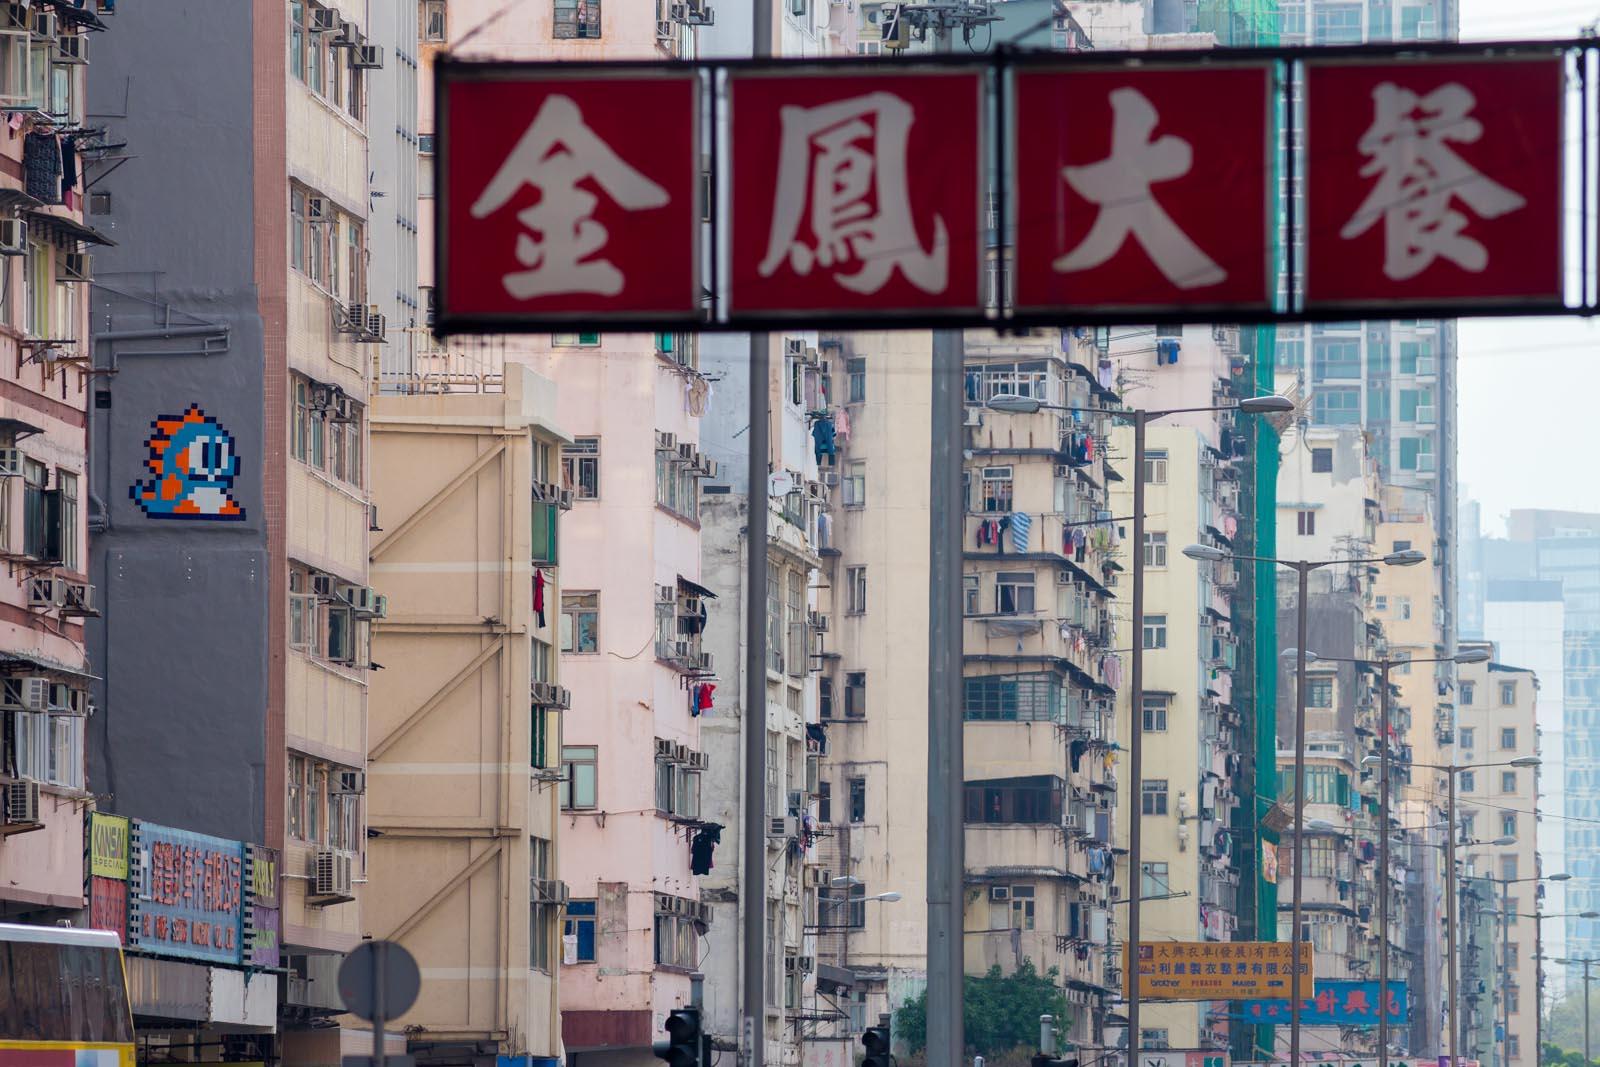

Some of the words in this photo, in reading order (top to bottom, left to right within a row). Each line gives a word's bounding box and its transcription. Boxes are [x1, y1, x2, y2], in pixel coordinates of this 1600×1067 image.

[470, 82, 1526, 301] 金鳳大餐
[94, 823, 125, 859] KANSAI
[94, 857, 124, 870] SPECIAL
